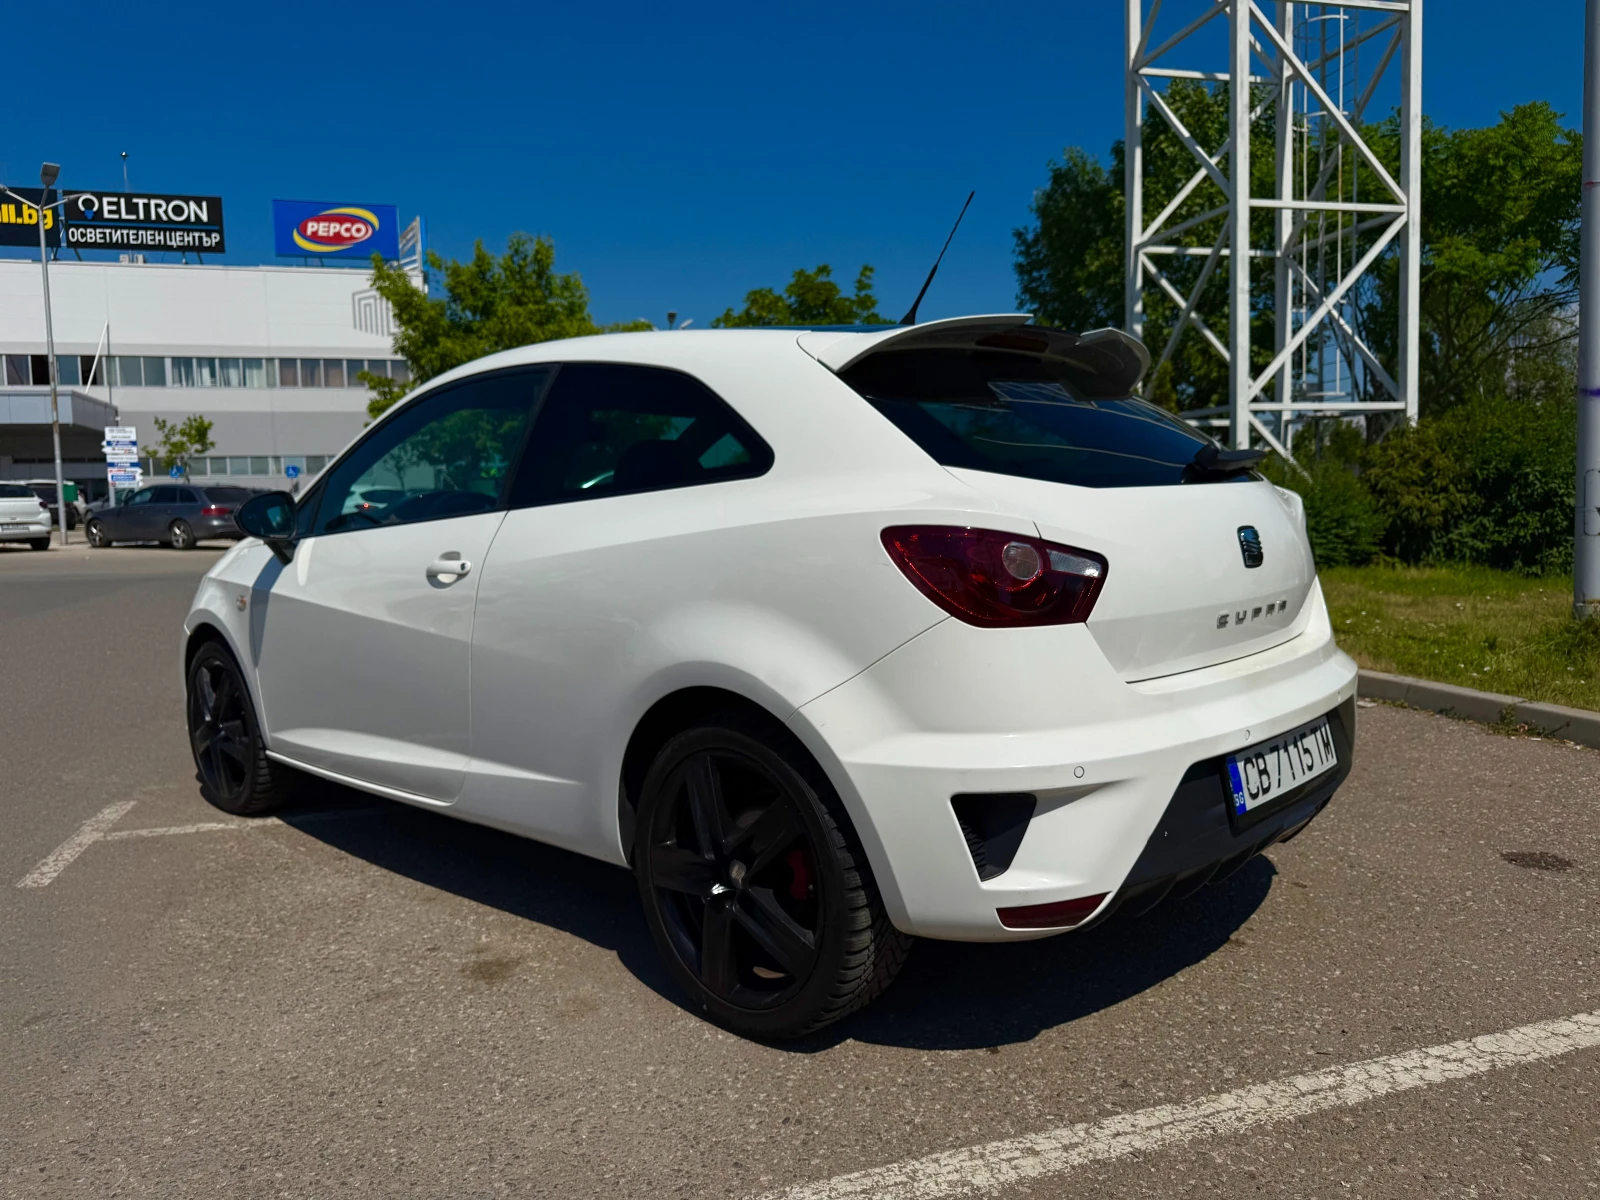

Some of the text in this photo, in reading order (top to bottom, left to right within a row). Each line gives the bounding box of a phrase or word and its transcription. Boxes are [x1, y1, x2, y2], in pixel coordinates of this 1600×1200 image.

[0, 203, 53, 230] ll.bg
[102, 196, 209, 223] ELTRON
[68, 227, 220, 248] ОСВЕТИТЕЛЕН ЦЕНТЪР
[306, 221, 367, 238] PEPCO
[1216, 600, 1287, 630] CUPRA
